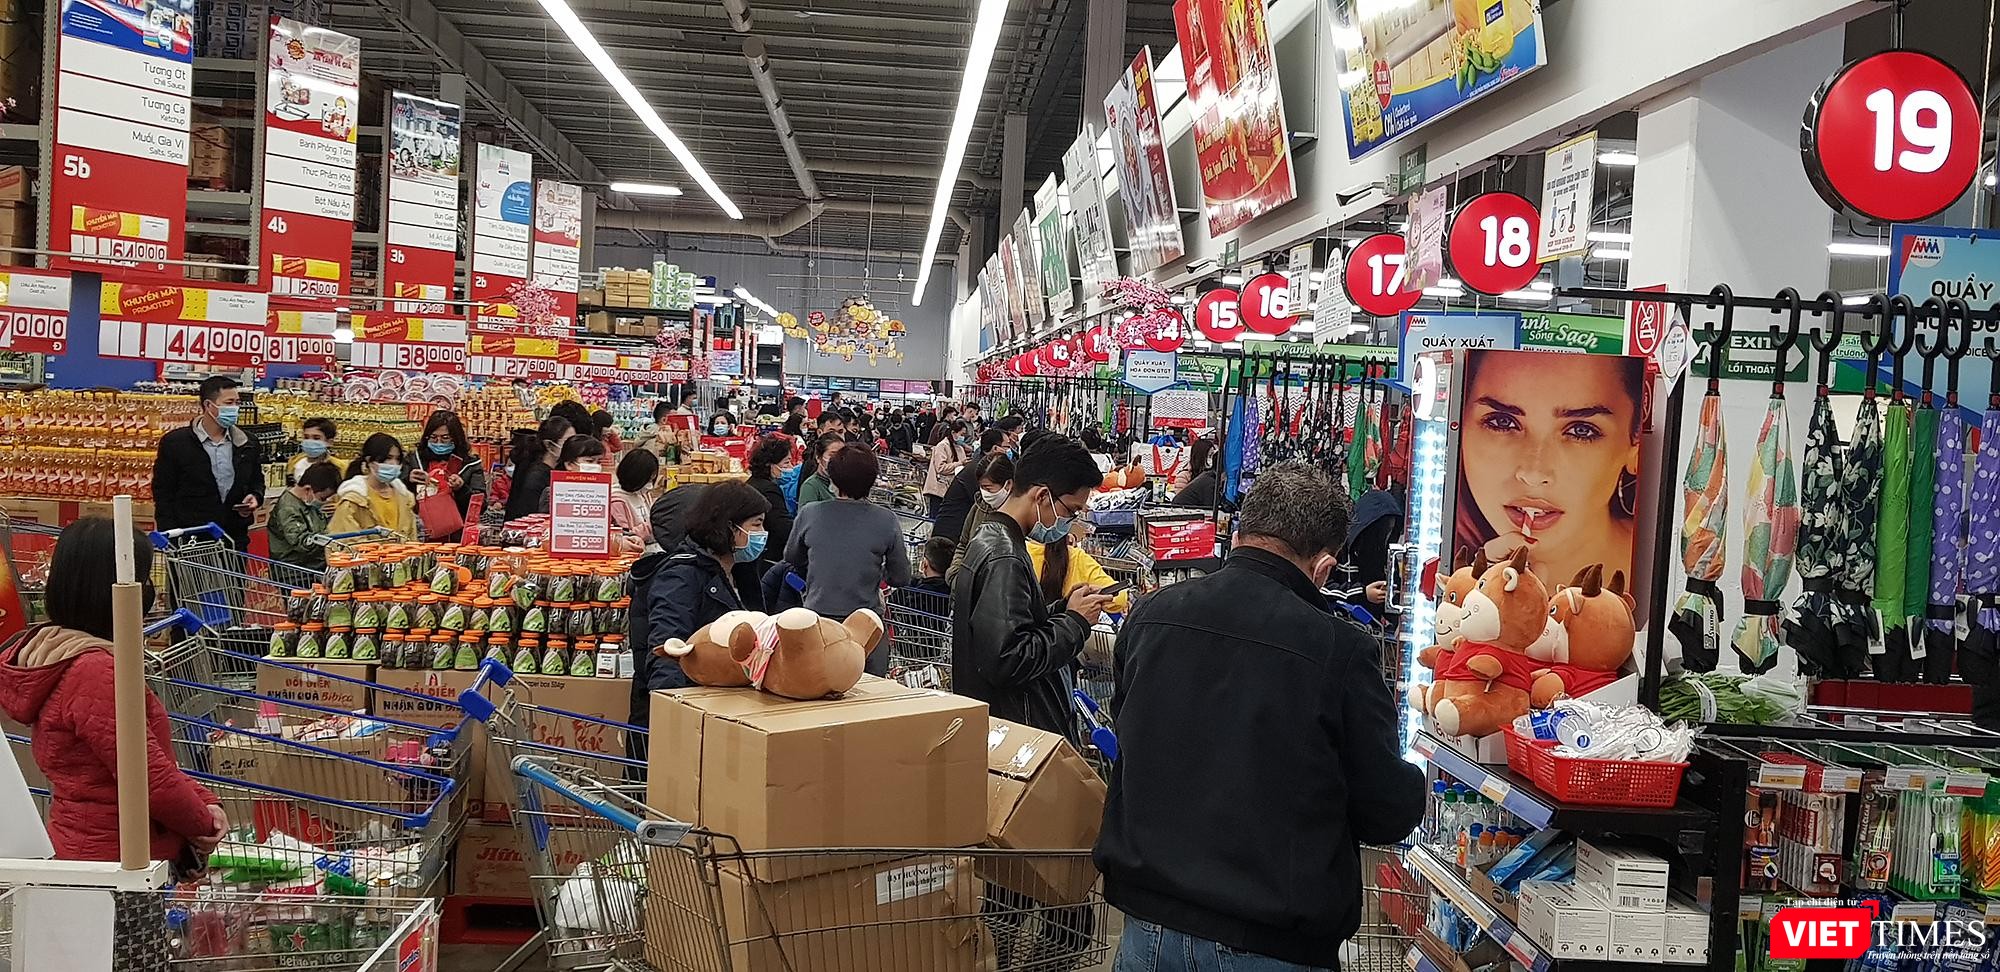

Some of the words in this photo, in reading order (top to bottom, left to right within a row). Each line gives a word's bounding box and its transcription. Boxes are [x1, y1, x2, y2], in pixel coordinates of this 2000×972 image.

[144, 62, 172, 80] Tương
[142, 96, 171, 114] Tương
[1866, 88, 1952, 173] 19
[62, 154, 91, 179] 5b
[267, 216, 287, 234] 4b
[1480, 215, 1530, 268] 18
[390, 249, 405, 264] 3b
[475, 276, 487, 288] 2b
[1367, 254, 1408, 296] 17
[1930, 272, 1994, 301] QUẦY
[123, 290, 159, 308] KHUYẾN
[132, 298, 174, 316] PROMOTION
[1259, 285, 1289, 319] 16
[1208, 300, 1238, 329] 15
[1422, 335, 1456, 349] QUẦY
[1460, 334, 1494, 349] XUẤT
[1528, 327, 1554, 342] Sống
[1558, 322, 1599, 349] Sạch
[1728, 362, 1744, 374] LỐI
[1746, 362, 1776, 376] THOÁT
[322, 691, 354, 704] Bibica
[384, 700, 414, 714] NHẬN
[1956, 908, 1966, 918] 40
